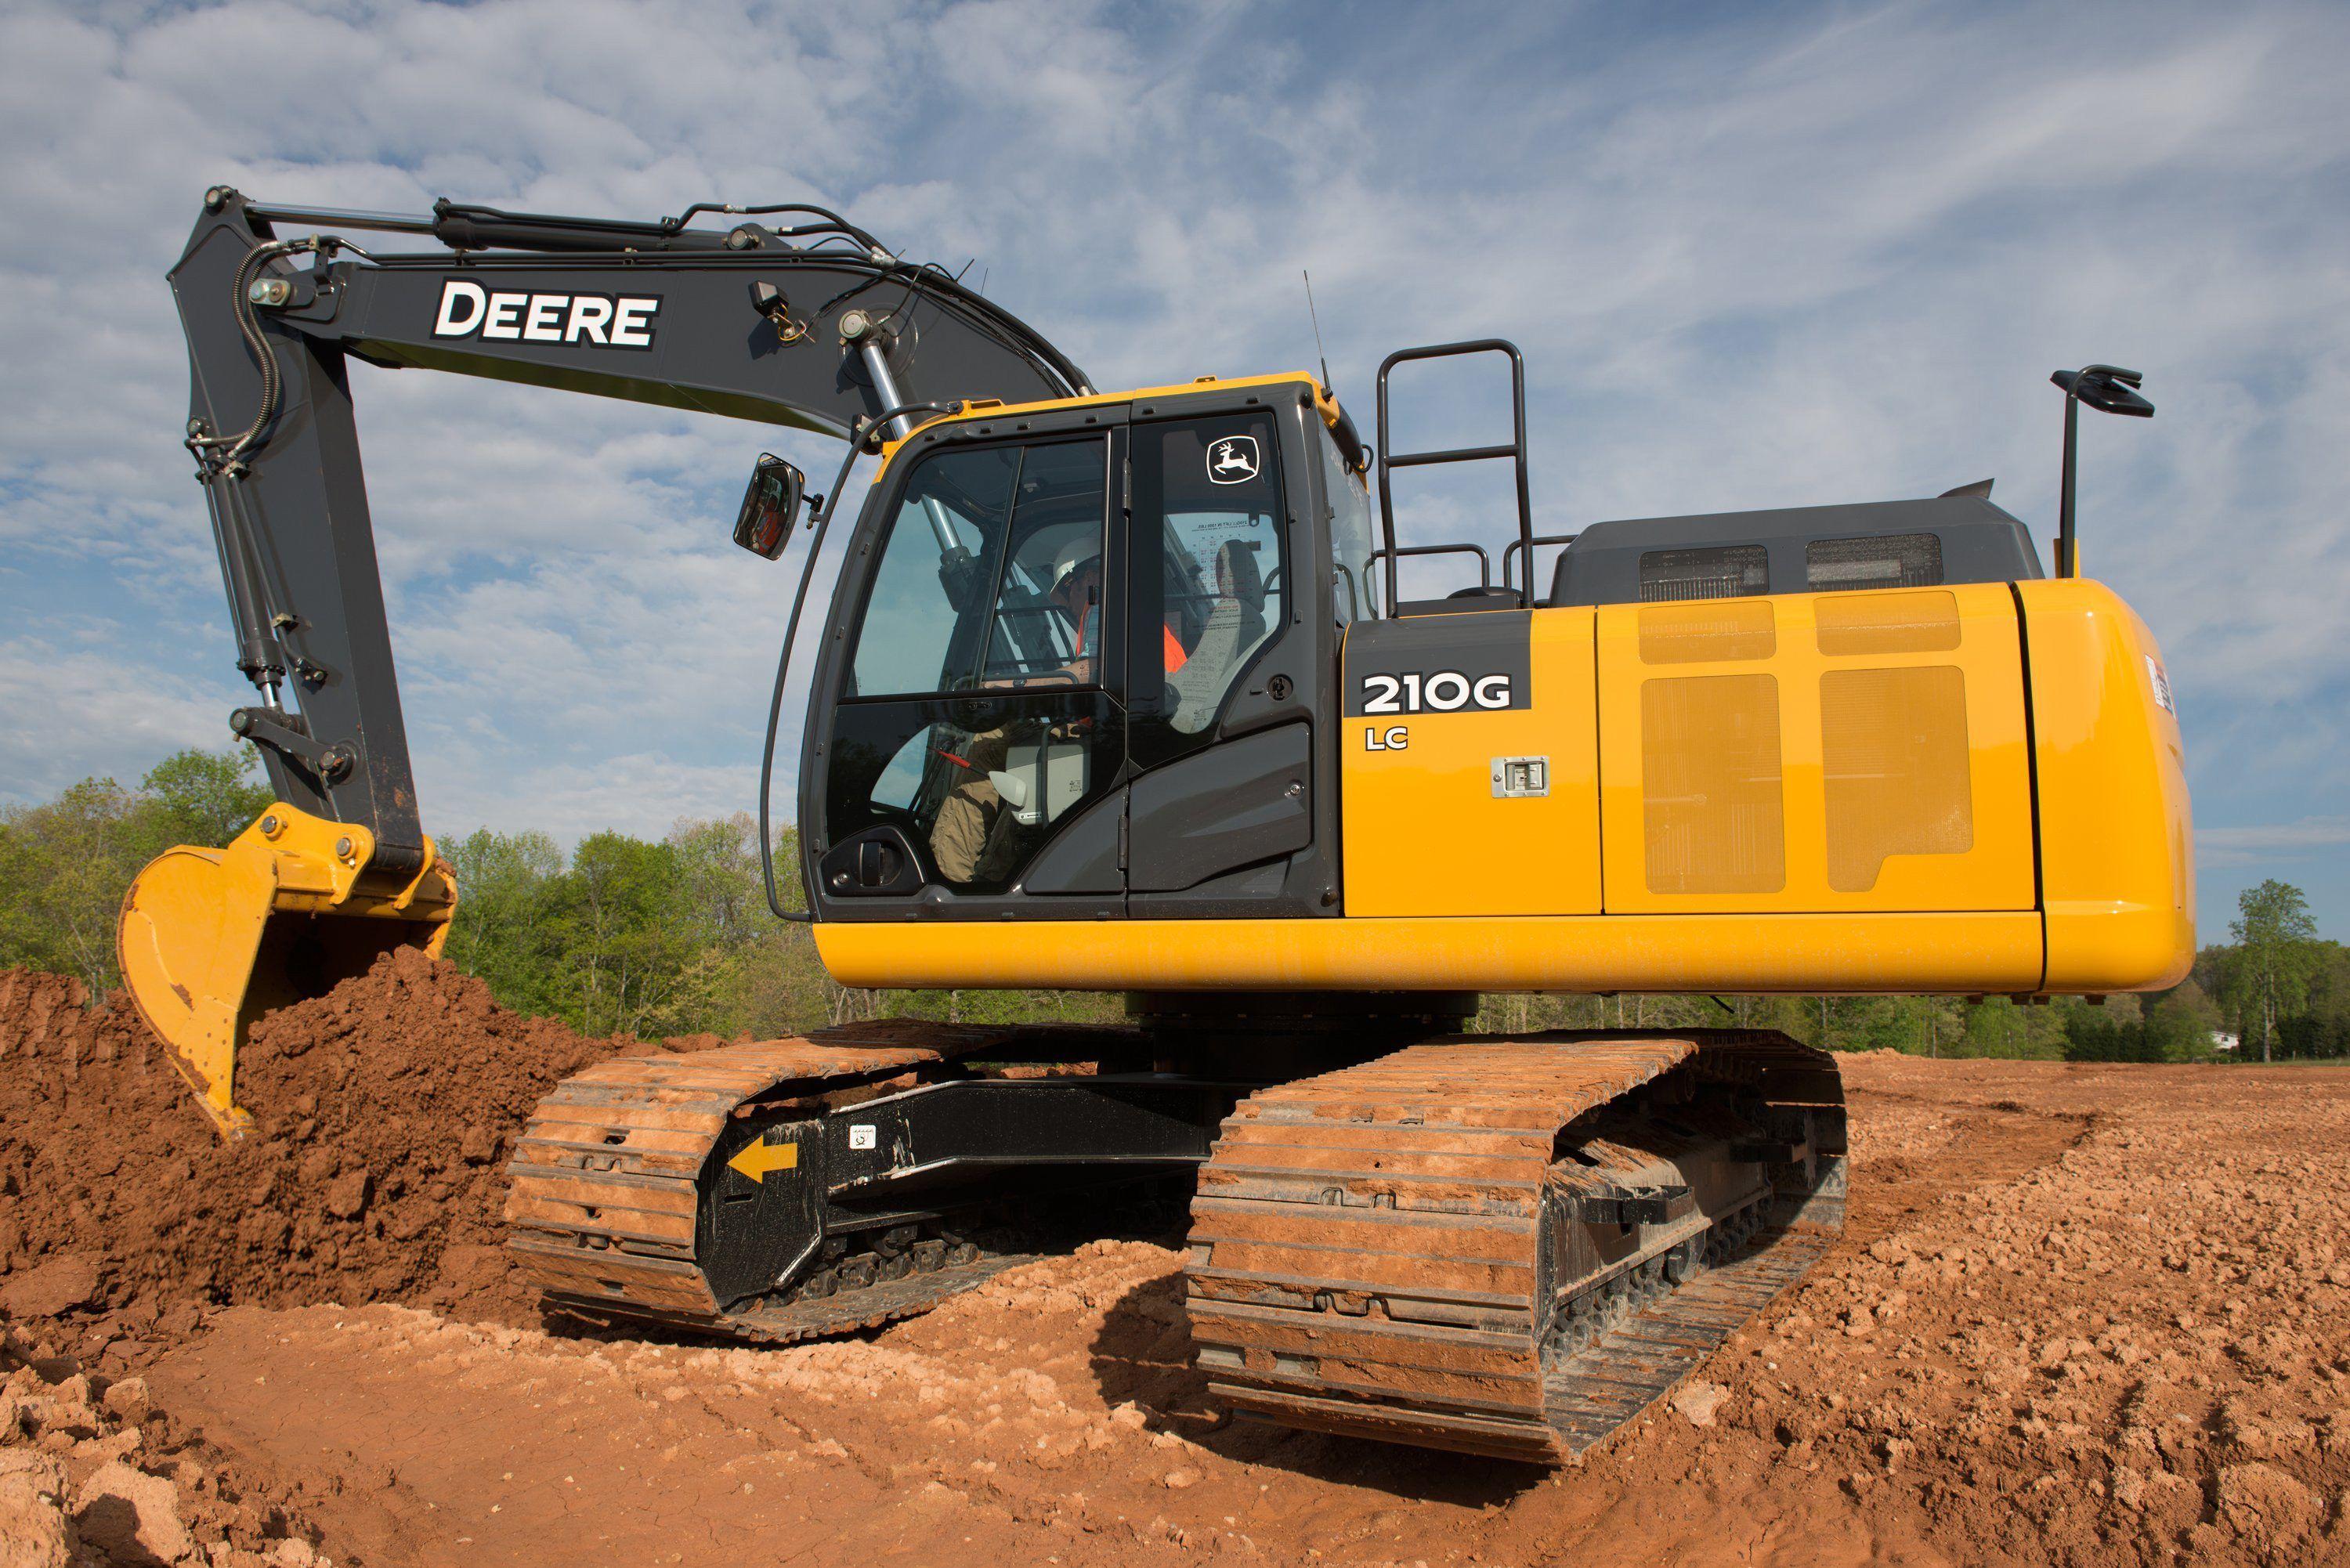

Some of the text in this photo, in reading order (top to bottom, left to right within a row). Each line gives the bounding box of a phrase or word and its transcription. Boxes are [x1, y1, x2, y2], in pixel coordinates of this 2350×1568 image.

[434, 280, 659, 347] DEERE
[1363, 671, 1511, 714] 210G
[1366, 727, 1408, 750] LC
